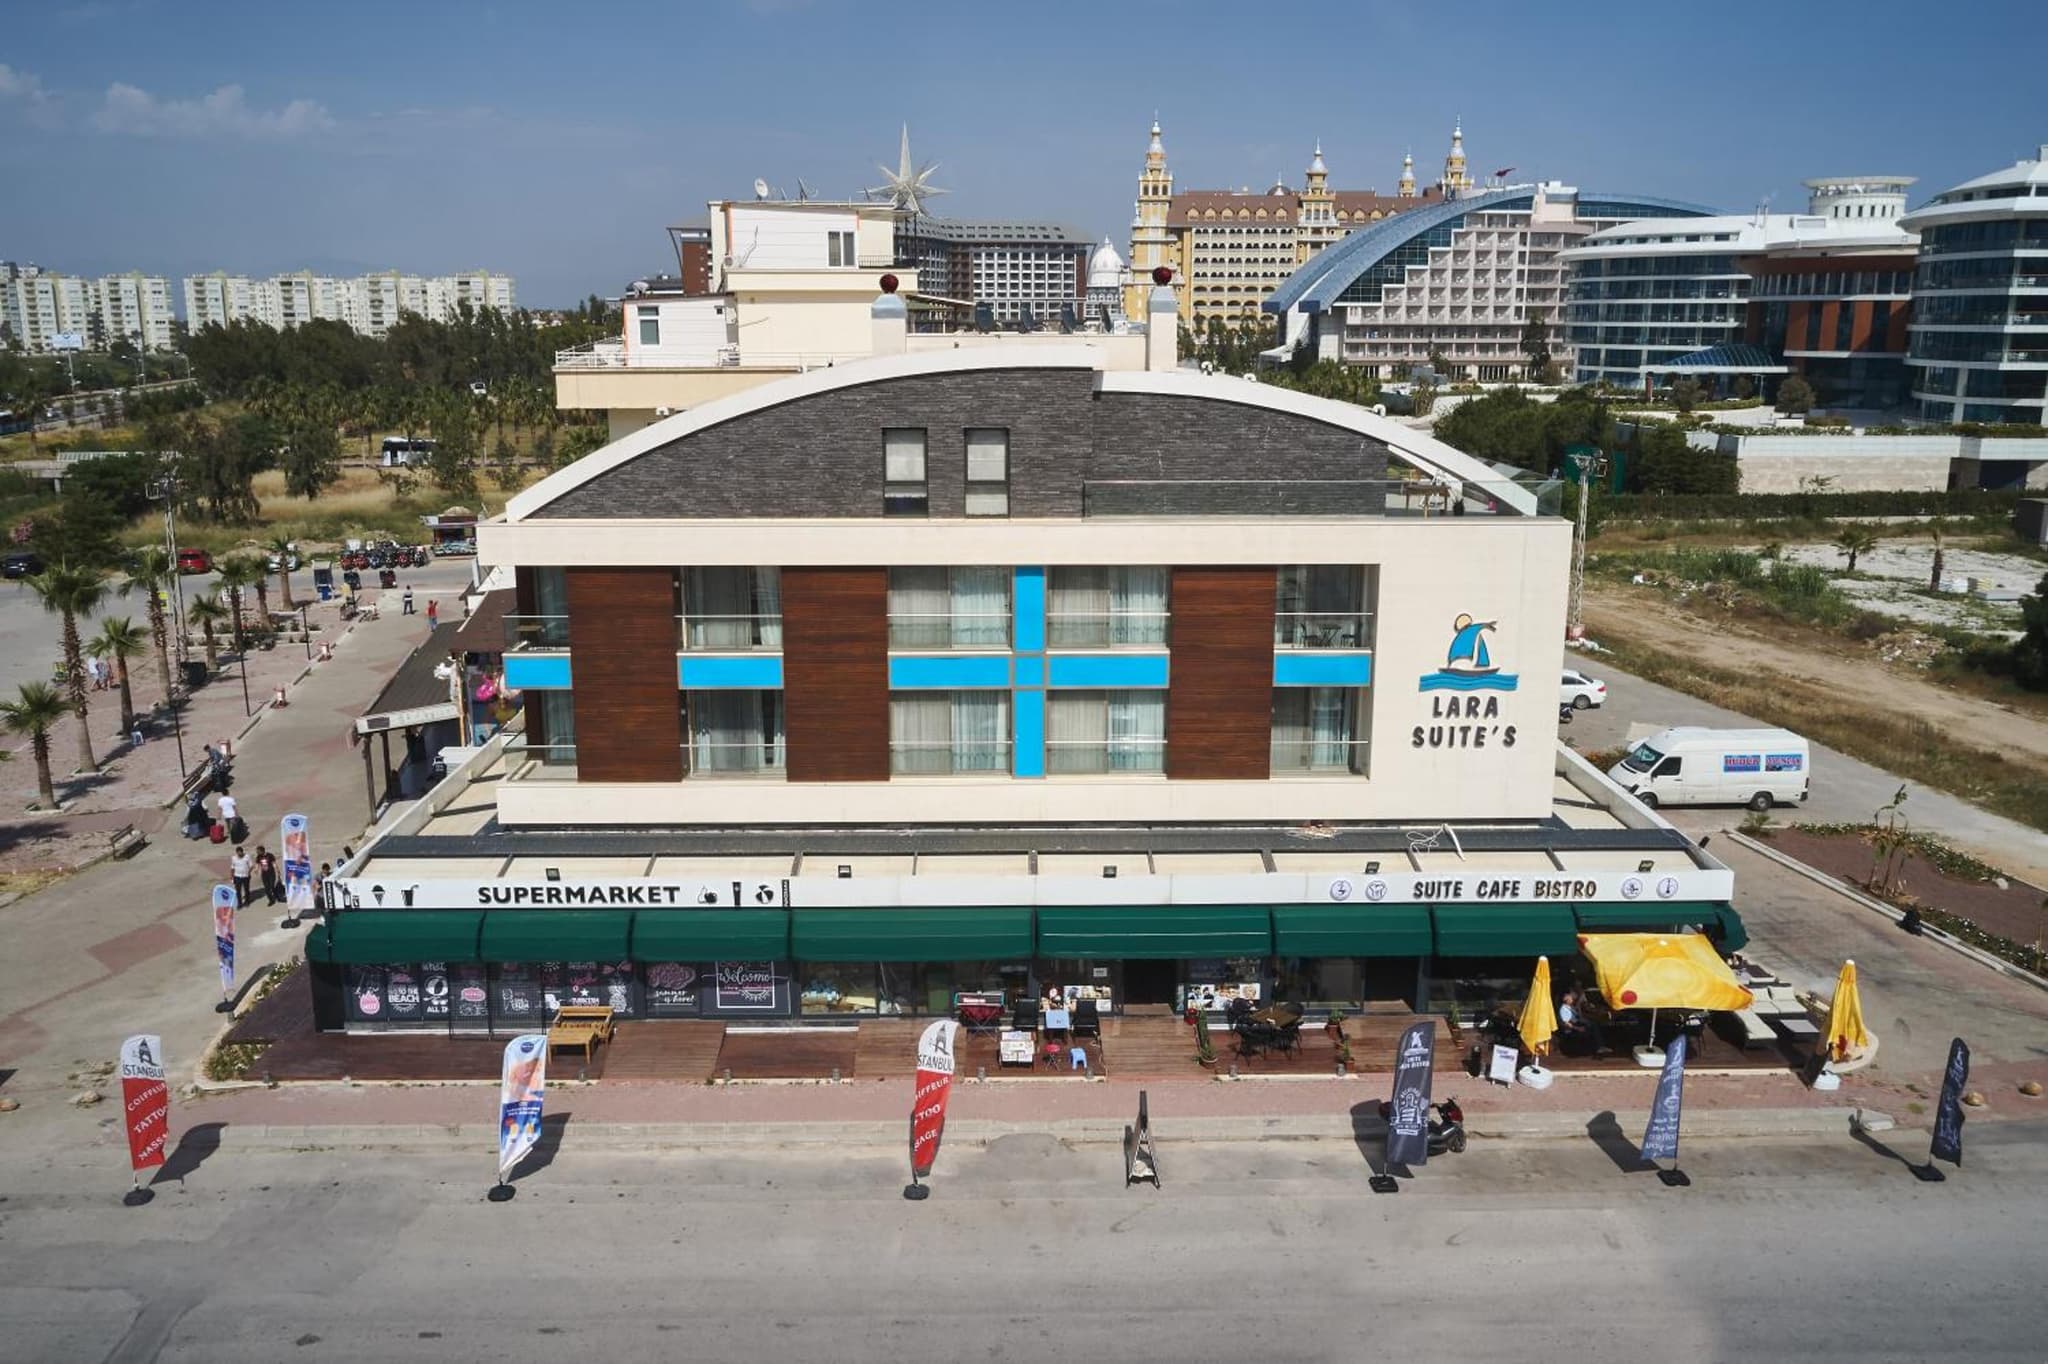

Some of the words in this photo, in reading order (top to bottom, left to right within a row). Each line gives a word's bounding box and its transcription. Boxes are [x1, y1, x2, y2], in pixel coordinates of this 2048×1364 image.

[1432, 696, 1498, 719] LARA
[1412, 725, 1517, 748] SUITE'S
[479, 886, 681, 905] SUPERMARKET
[1413, 880, 1464, 899] SUITE
[1476, 880, 1521, 899] CAFE
[1534, 881, 1598, 898] BISTRO
[388, 994, 420, 1003] BEACH
[916, 1053, 953, 1072] STANBUL
[915, 1076, 949, 1101] IFFEUR
[914, 1129, 938, 1152] SAGE
